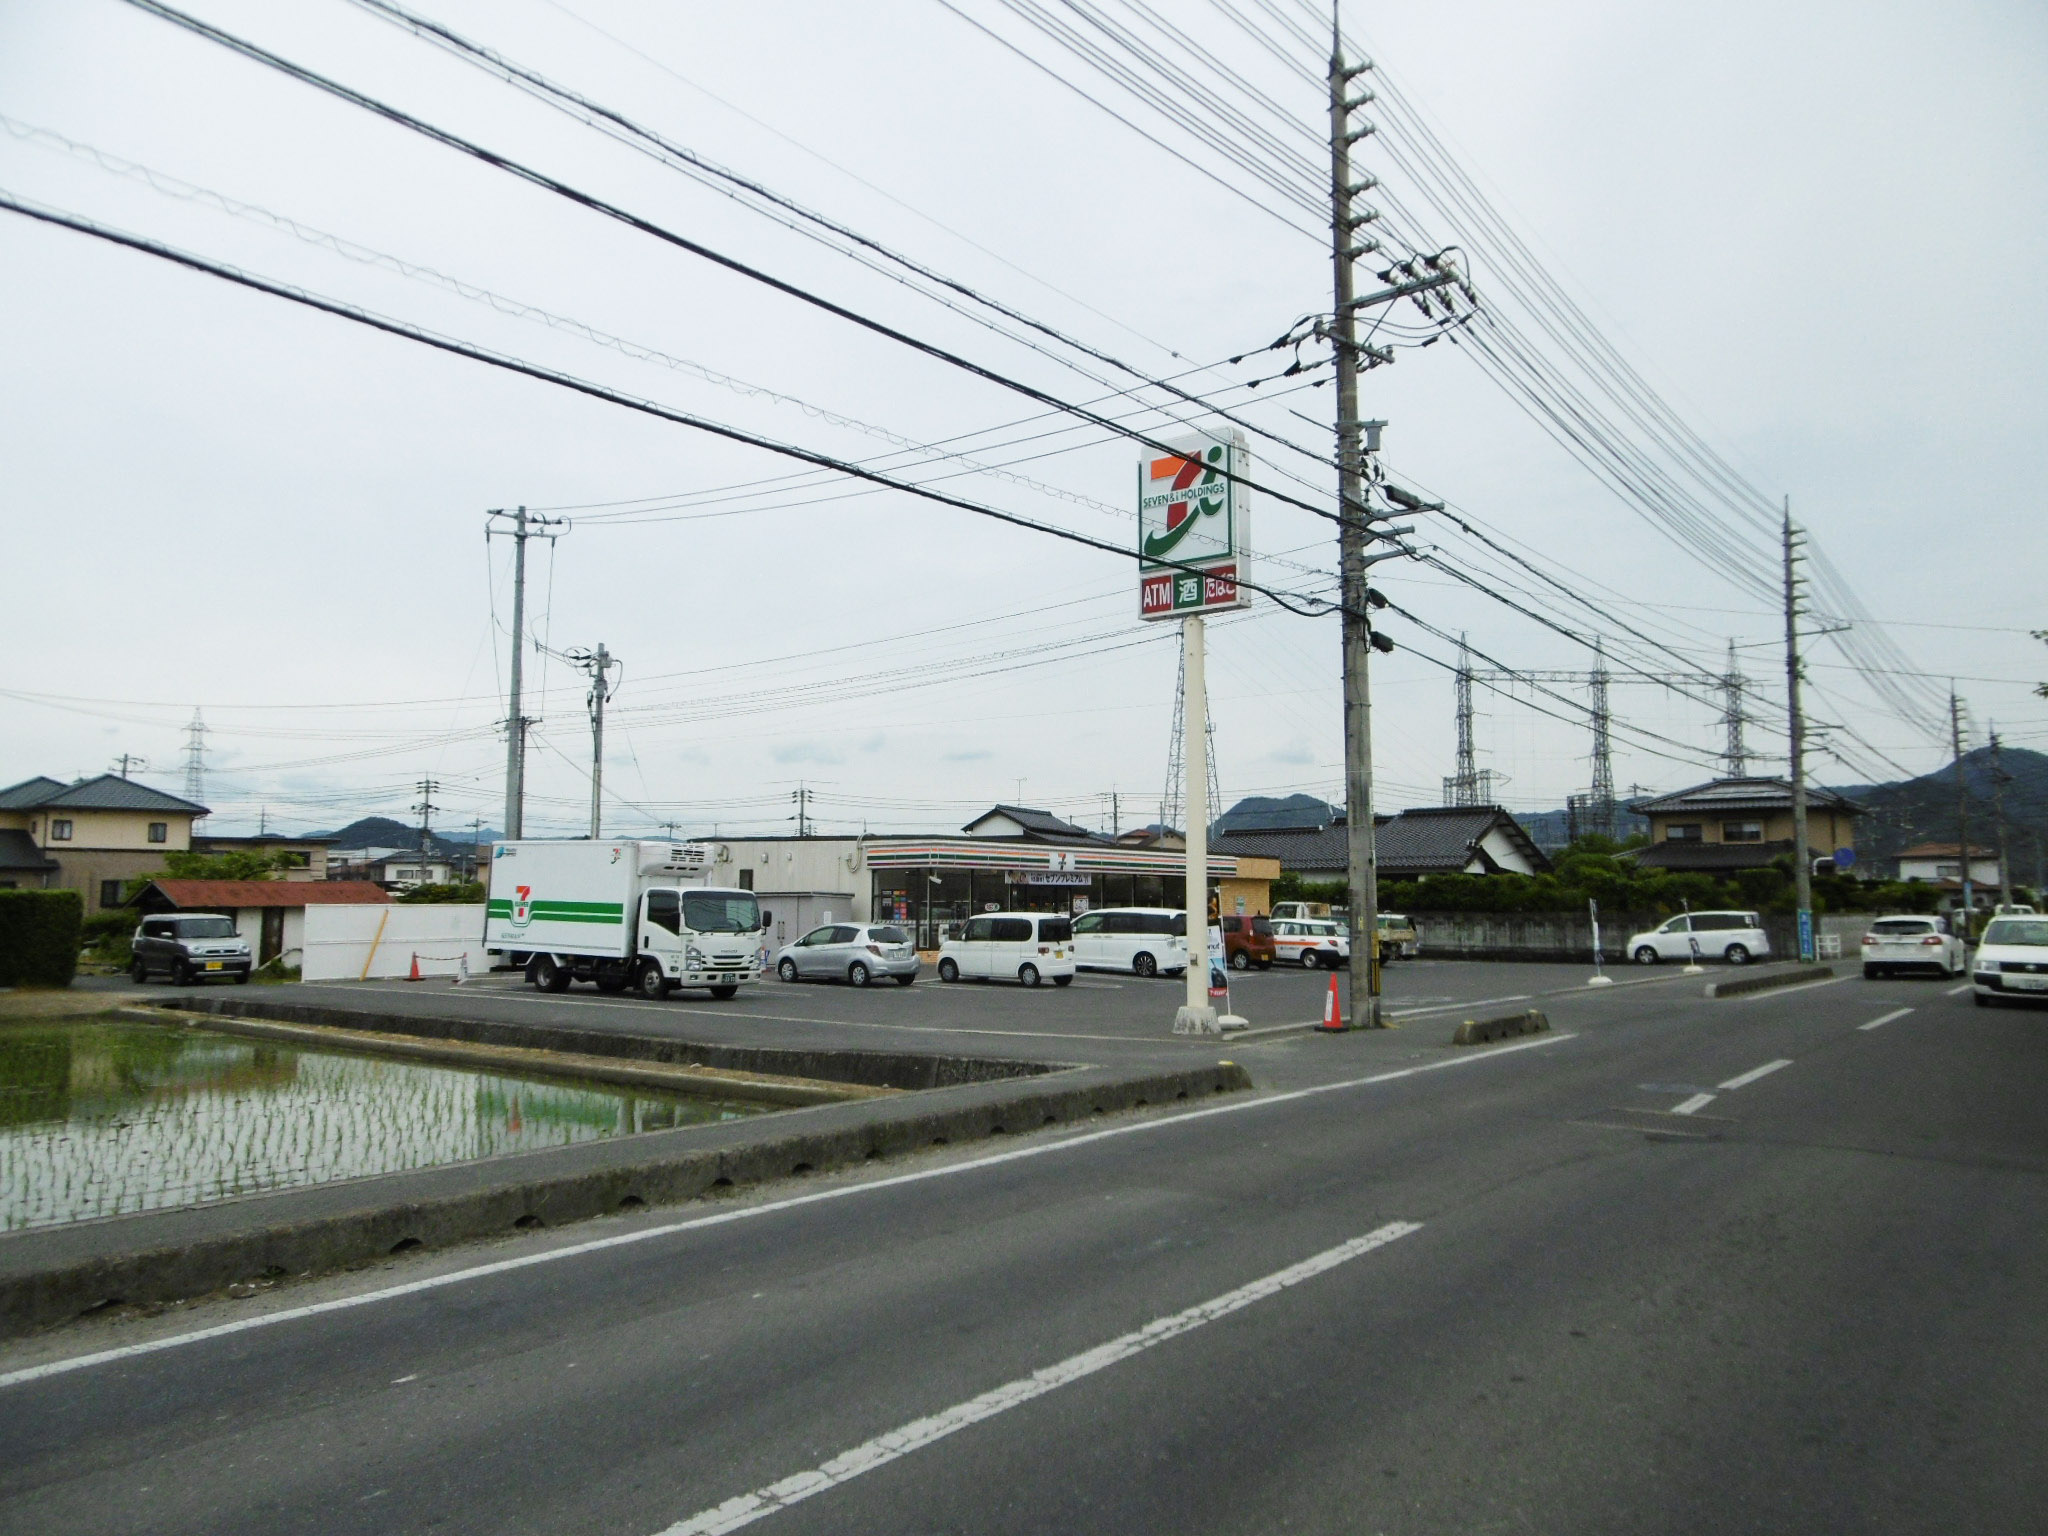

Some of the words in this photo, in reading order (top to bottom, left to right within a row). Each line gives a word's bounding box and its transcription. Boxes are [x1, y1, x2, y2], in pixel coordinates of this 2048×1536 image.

[1181, 482, 1225, 499] HOLDINGS
[1143, 582, 1170, 608] ATM
[1179, 578, 1198, 603] 酒
[1205, 573, 1236, 598] たばこ
